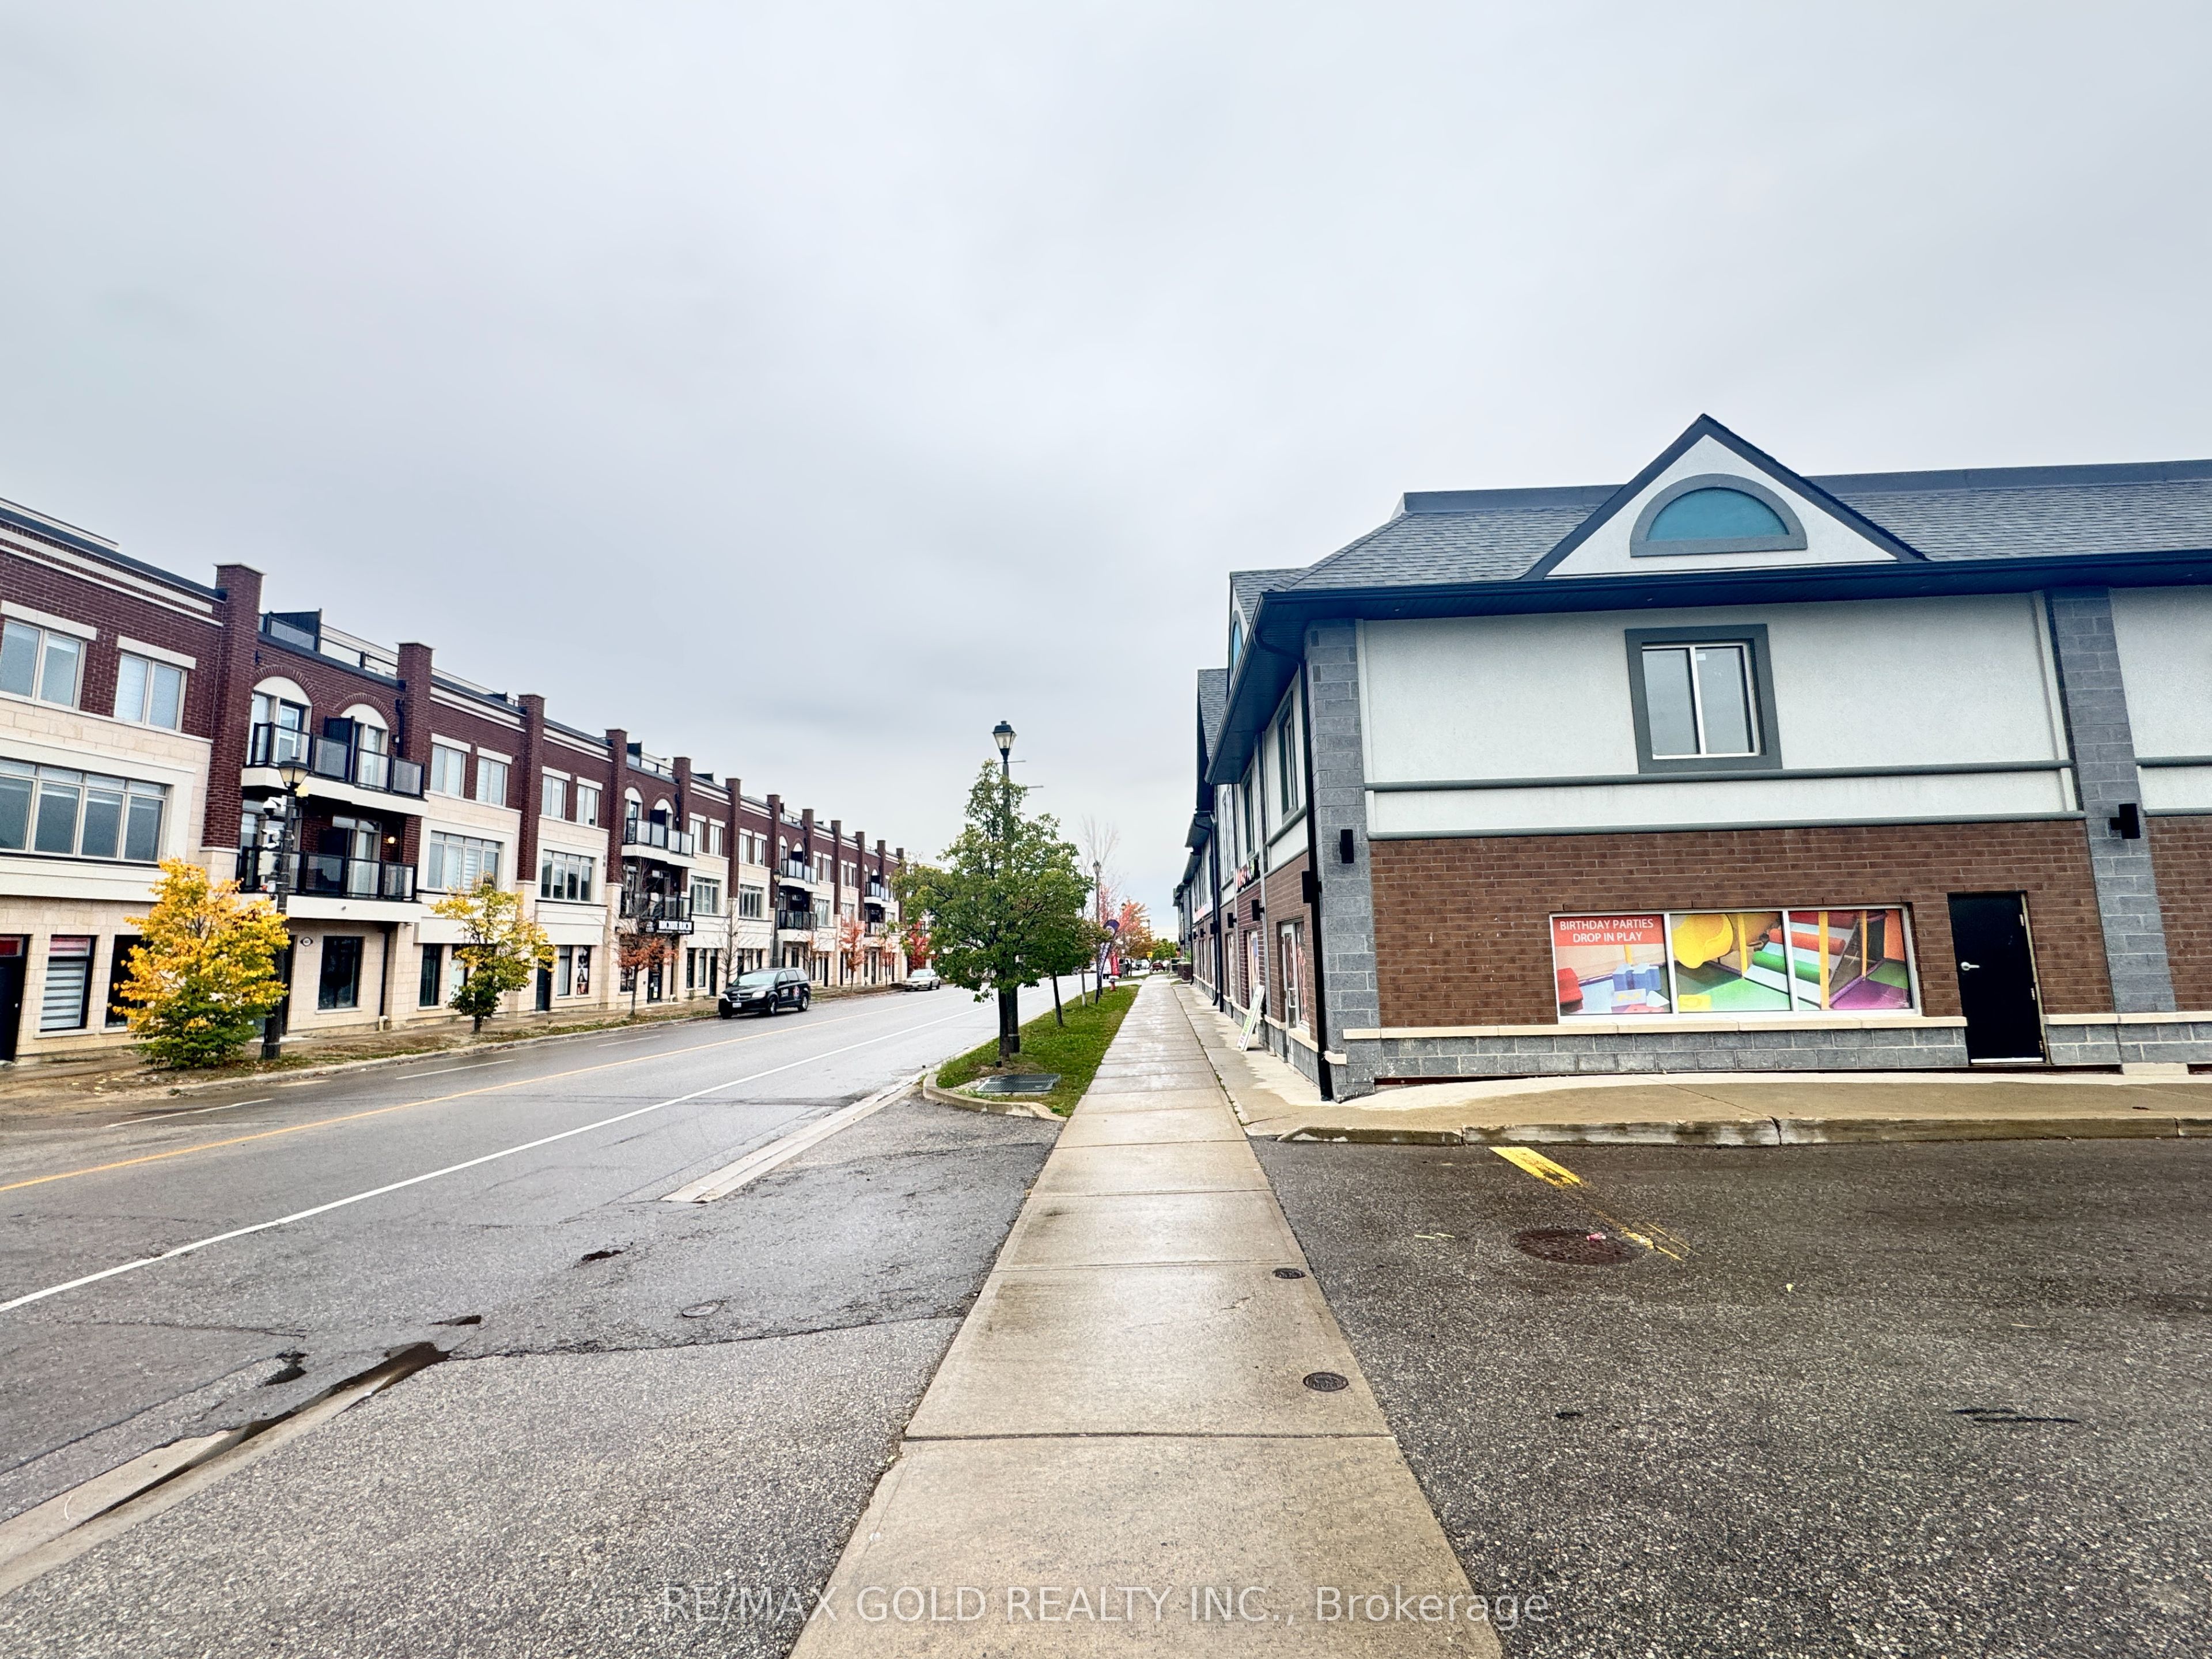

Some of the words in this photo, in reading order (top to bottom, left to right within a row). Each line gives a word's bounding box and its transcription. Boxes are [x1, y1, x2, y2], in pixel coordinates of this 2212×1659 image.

[1559, 920, 1610, 930] BIRTHDAY
[1613, 919, 1654, 929] PARTIES
[1573, 933, 1601, 943] DROP
[1604, 932, 1615, 942] IN
[1617, 931, 1642, 942] PLAY
